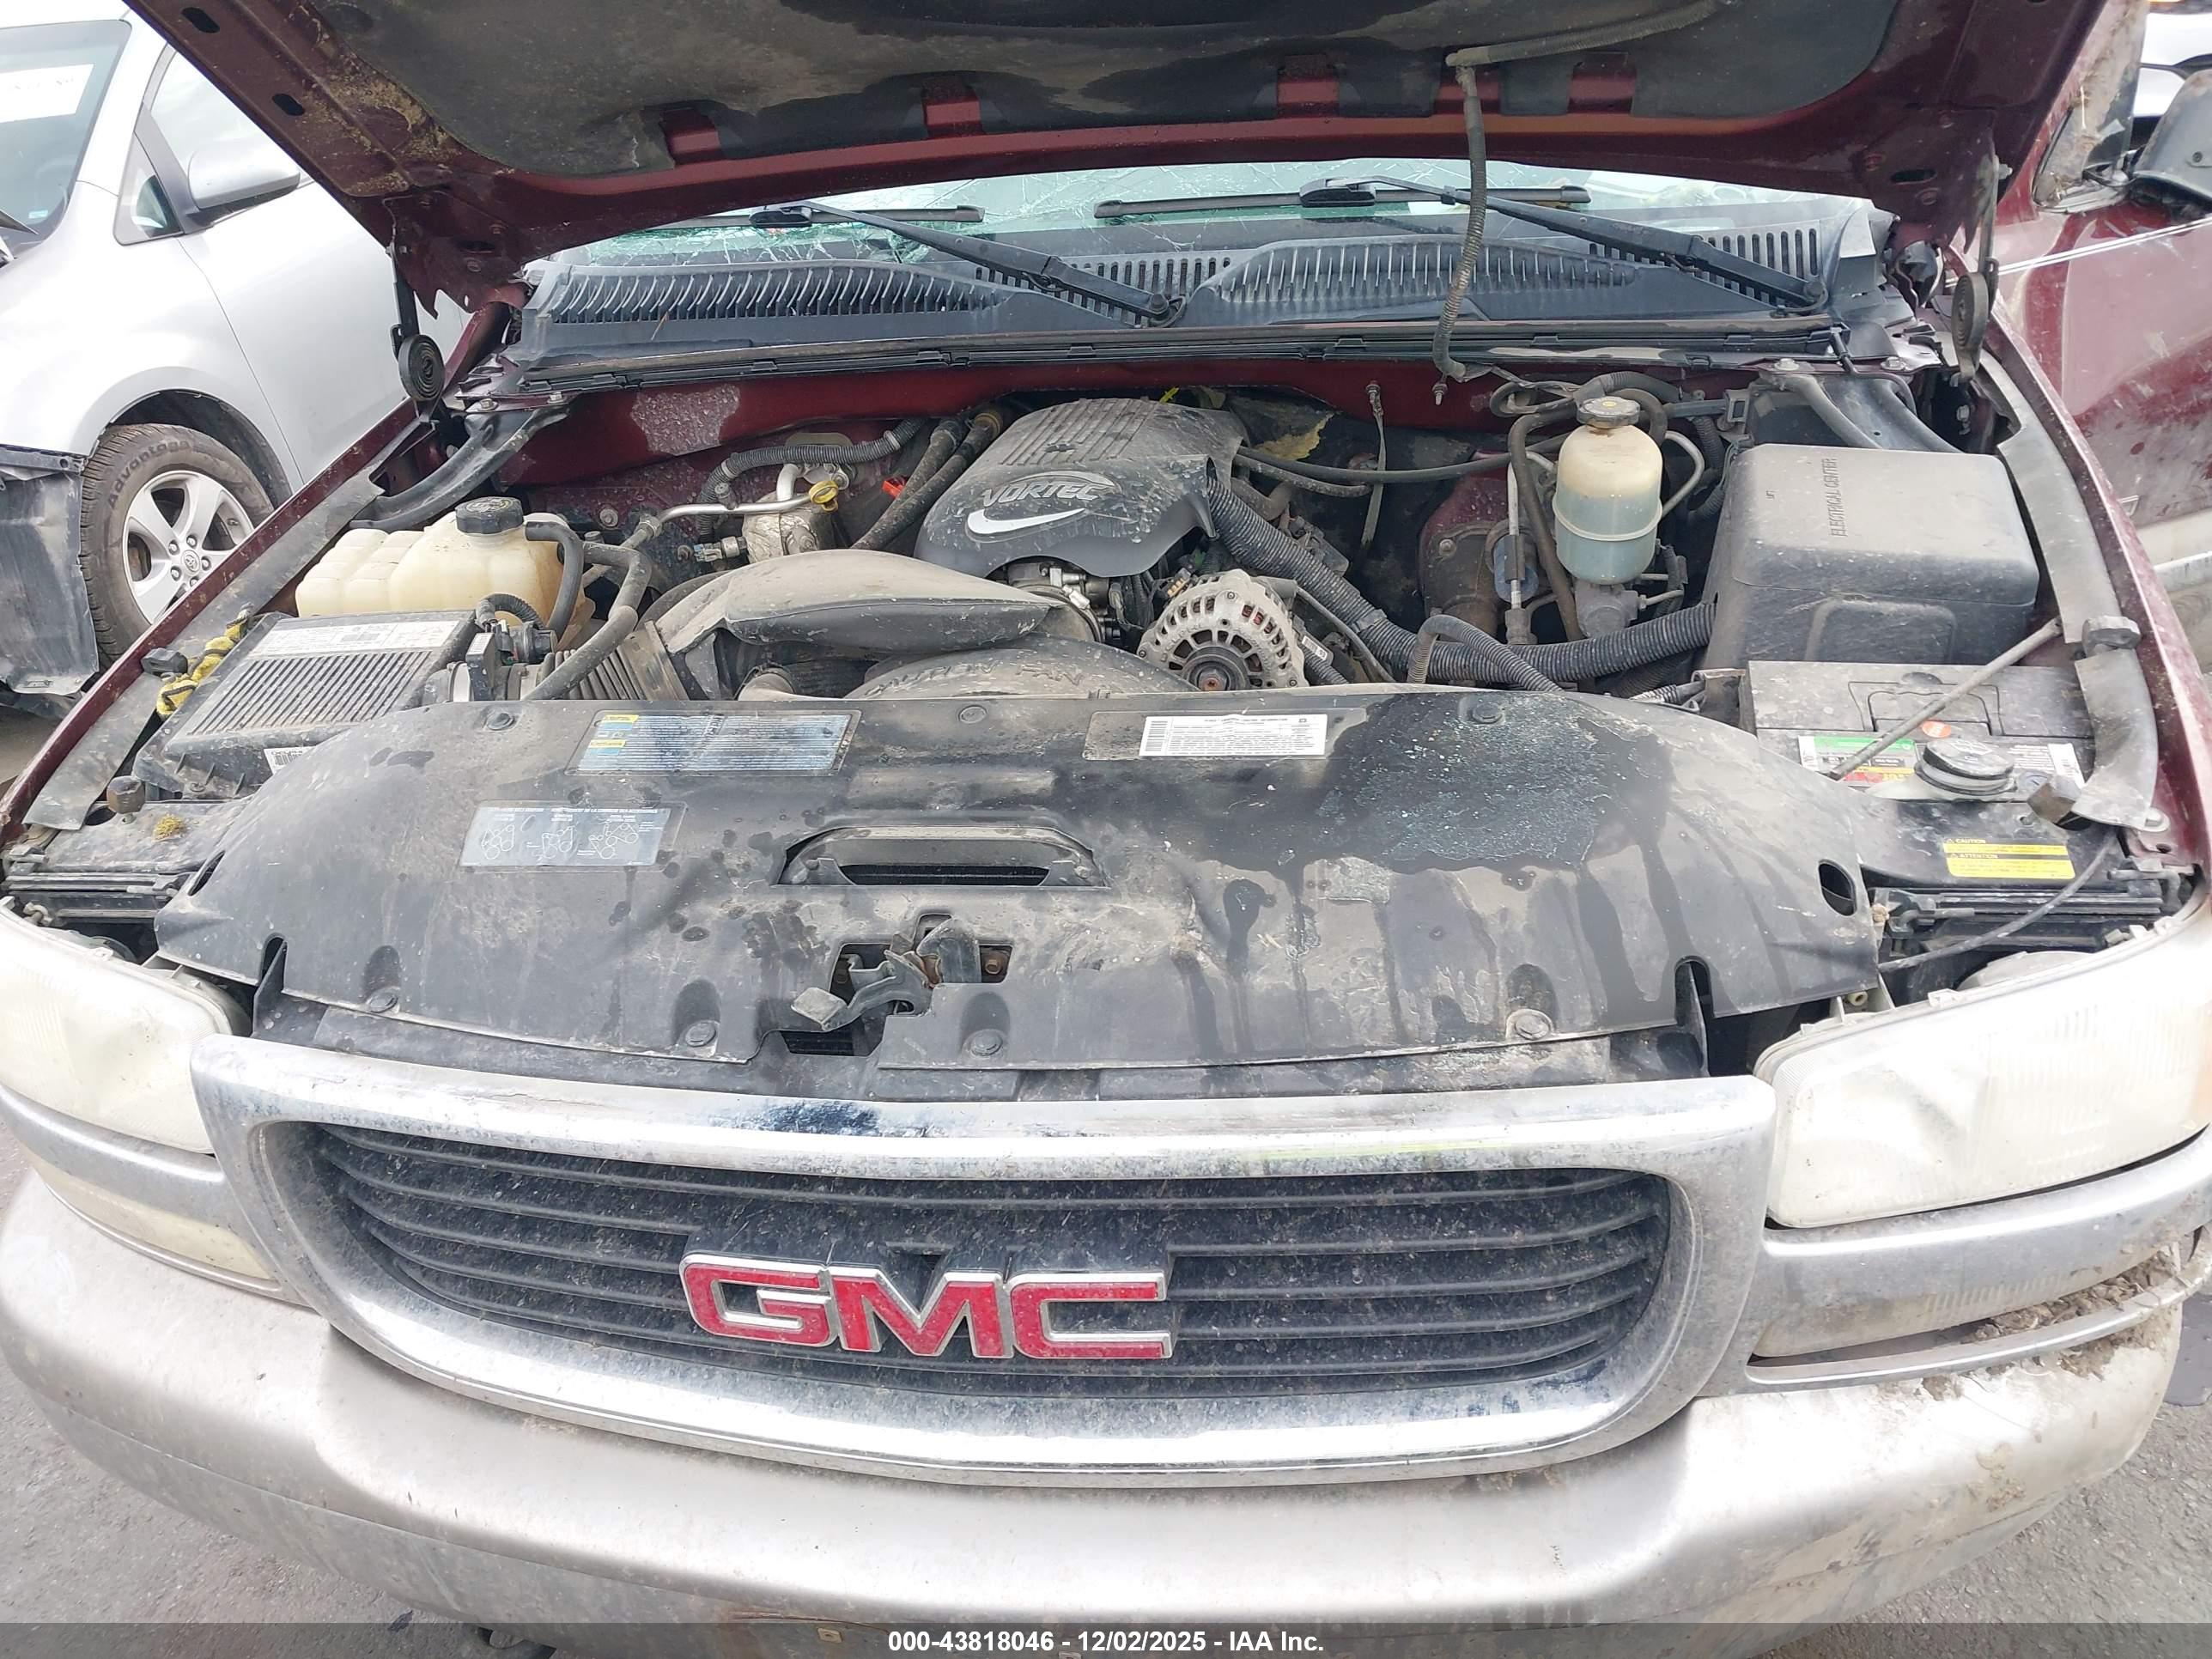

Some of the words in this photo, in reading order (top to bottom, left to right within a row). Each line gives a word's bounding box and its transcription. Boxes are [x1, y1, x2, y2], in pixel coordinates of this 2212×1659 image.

[1821, 458, 1839, 489] CENTER
[981, 480, 1110, 507] VORTEC
[679, 1252, 1174, 1360] GMC
